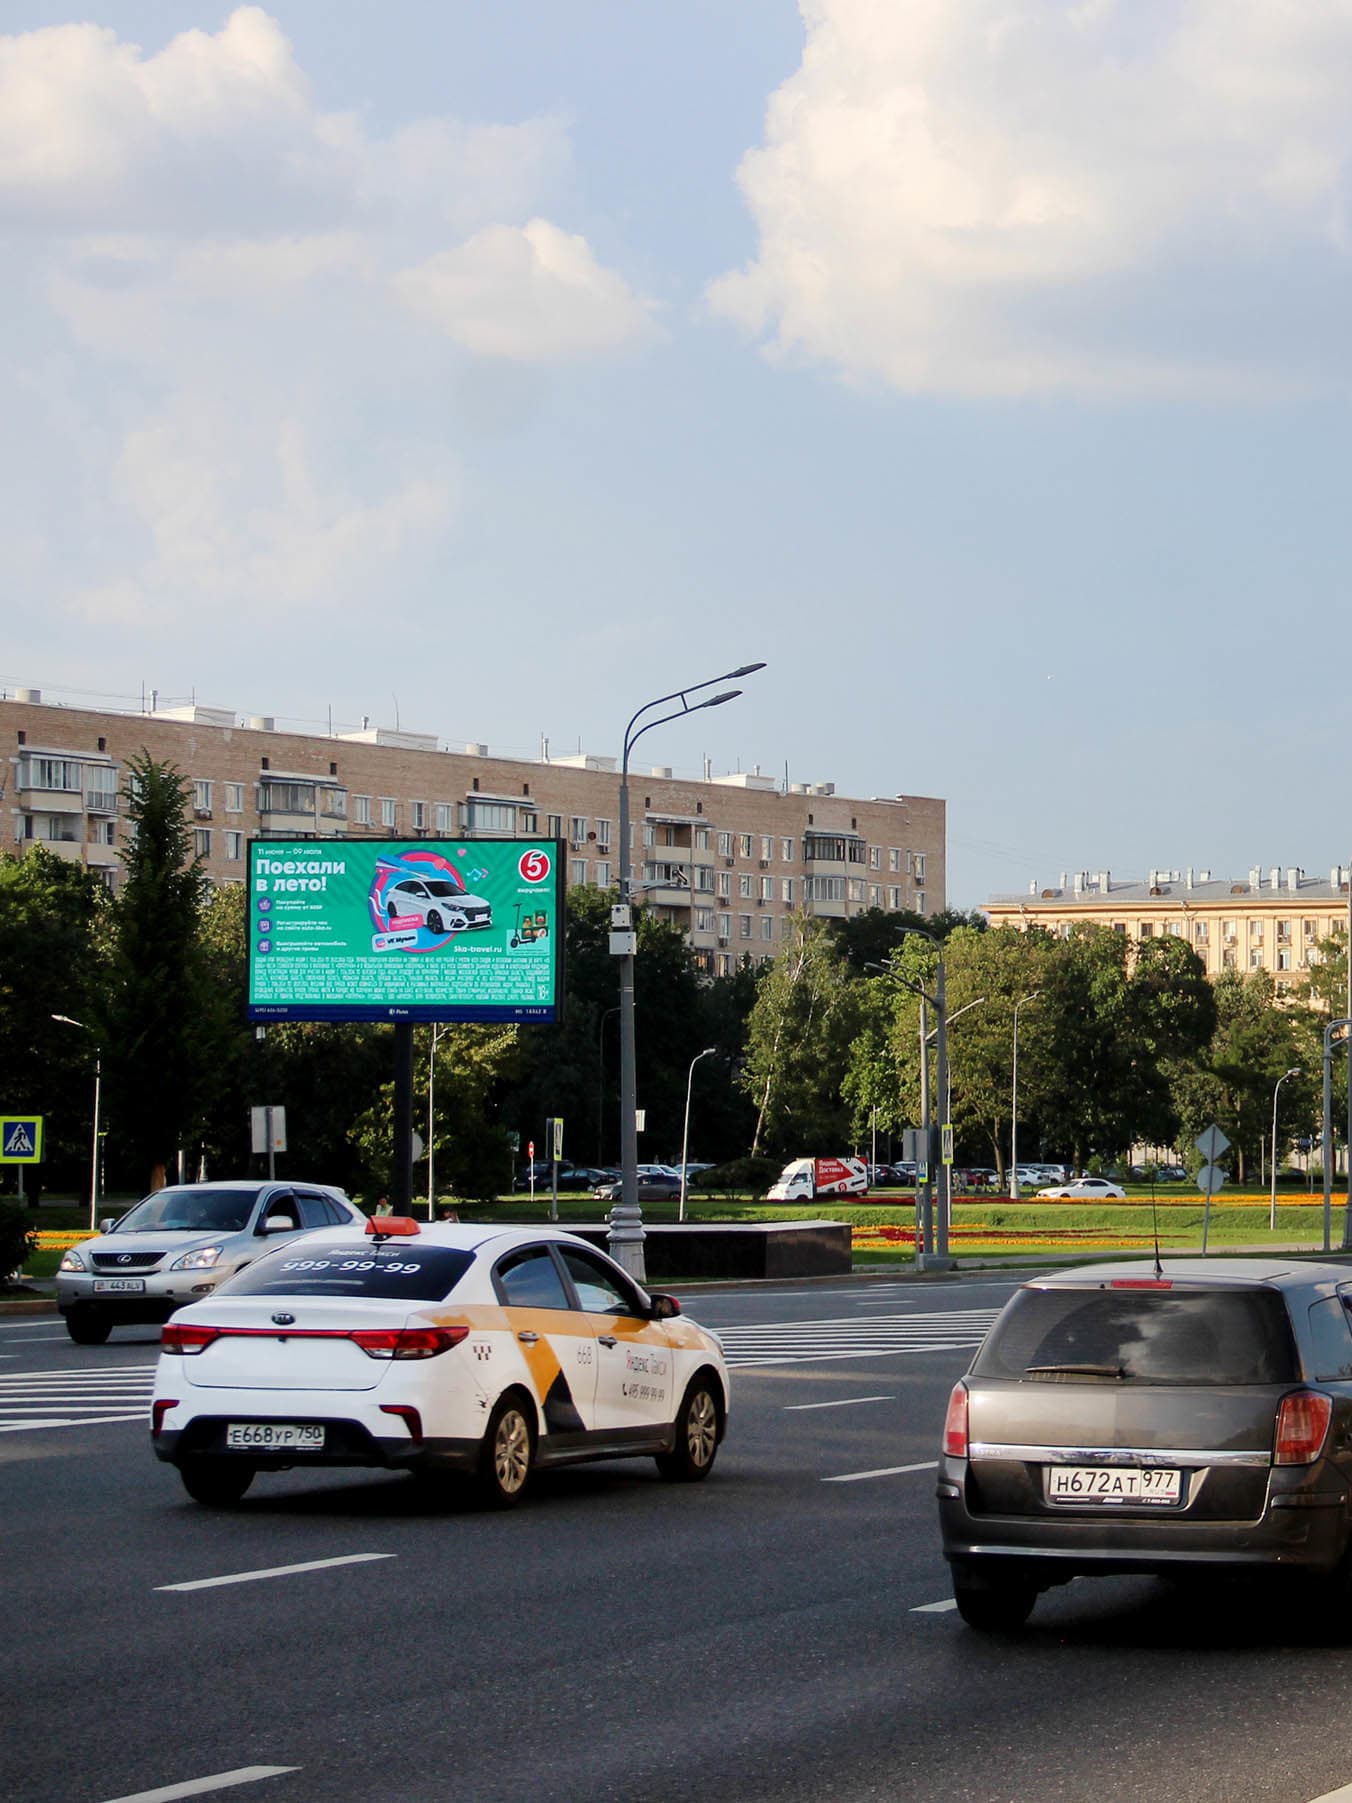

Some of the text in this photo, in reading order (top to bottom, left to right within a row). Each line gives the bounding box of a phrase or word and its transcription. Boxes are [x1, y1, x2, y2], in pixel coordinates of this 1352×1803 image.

[256, 858, 346, 875] Поехали
[256, 875, 327, 892] в лето!
[818, 1166, 844, 1174] Доставка
[279, 1259, 422, 1275] 999-99-99
